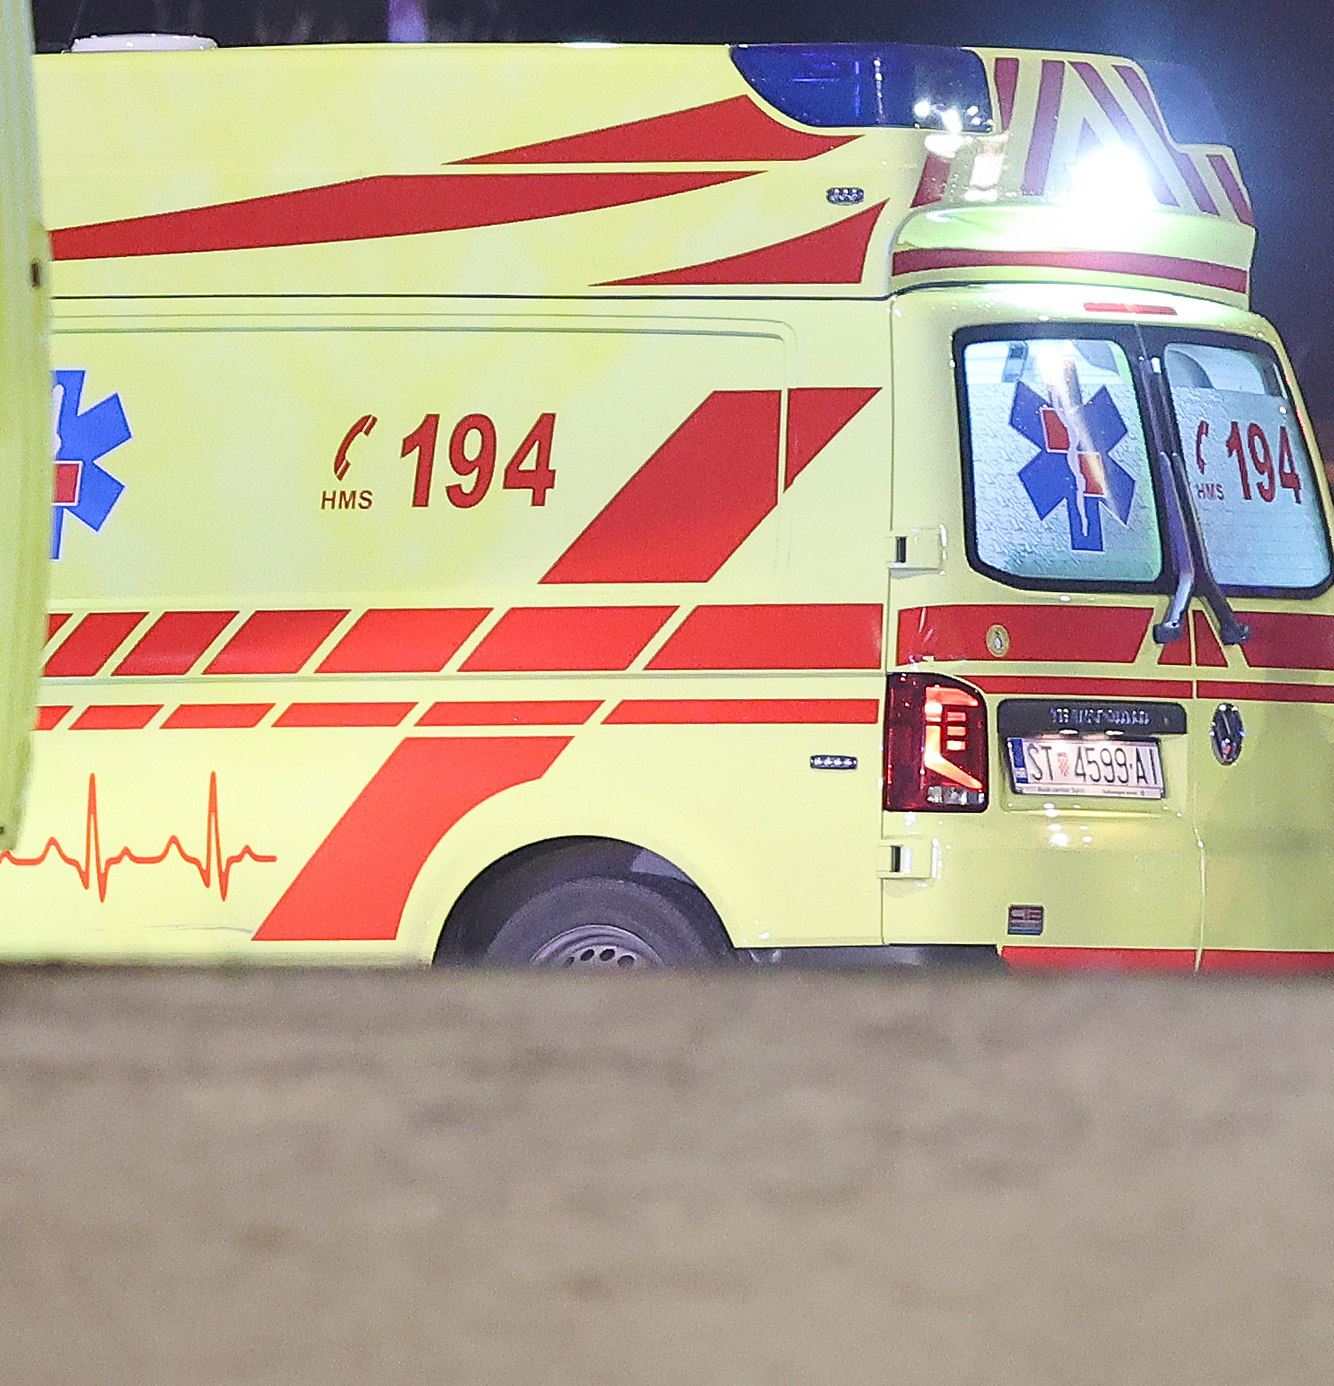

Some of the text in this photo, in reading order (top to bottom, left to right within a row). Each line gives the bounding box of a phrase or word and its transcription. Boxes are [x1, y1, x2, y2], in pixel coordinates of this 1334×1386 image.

[399, 412, 557, 509] 194
[1225, 420, 1302, 505] 194
[320, 489, 374, 510] HMS
[1195, 482, 1225, 501] HMS
[1026, 742, 1054, 782] ST
